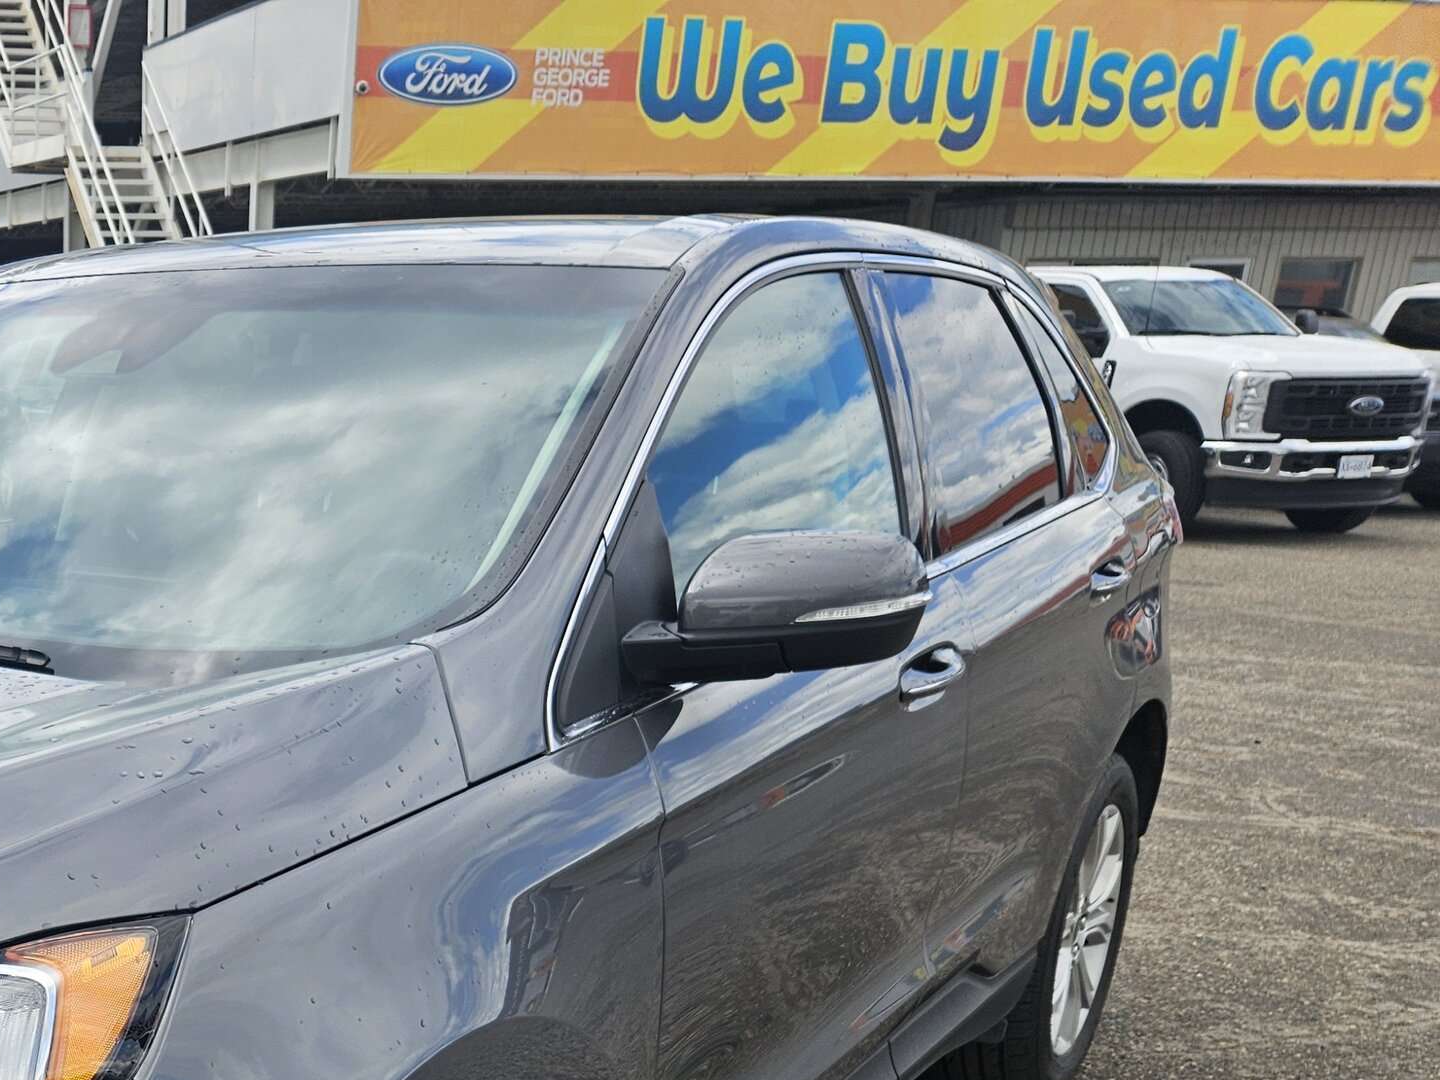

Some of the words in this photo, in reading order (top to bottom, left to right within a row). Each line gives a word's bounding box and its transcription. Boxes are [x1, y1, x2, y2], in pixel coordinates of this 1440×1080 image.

[535, 47, 605, 67] PRINCE
[406, 52, 489, 95] Ford
[533, 67, 610, 88] GEORGE
[638, 17, 796, 125] We
[820, 21, 1001, 153] Buy
[1024, 27, 1239, 130] Used
[1253, 34, 1431, 133] Cars
[530, 87, 583, 108] FORD
